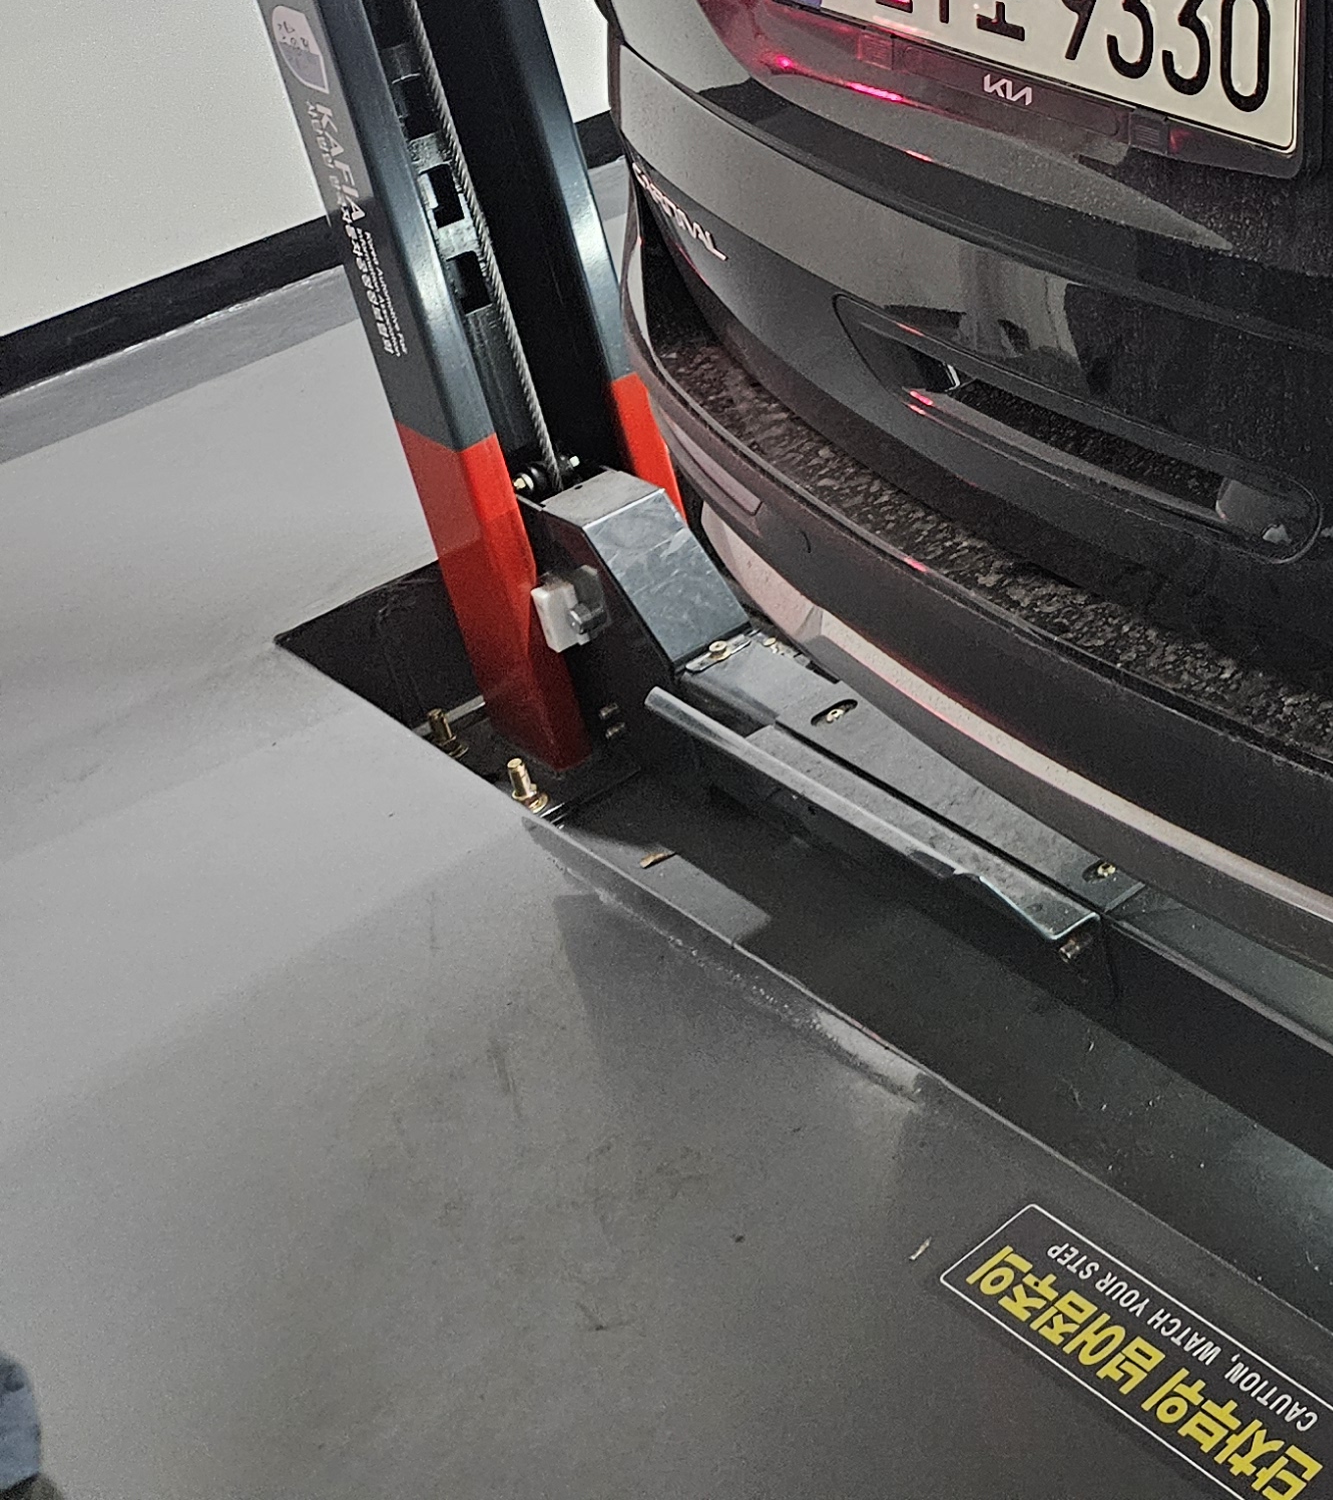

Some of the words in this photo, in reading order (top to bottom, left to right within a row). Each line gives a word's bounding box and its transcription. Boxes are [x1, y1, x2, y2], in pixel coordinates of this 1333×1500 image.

[983, 72, 1032, 106] KIA
[316, 103, 366, 221] KAFIA
[1046, 1242, 1101, 1281] STEP
[1095, 1267, 1151, 1318] YOUR
[965, 1244, 1166, 1396] 넘어짐주의
[1151, 1308, 1222, 1366] WATCH
[1224, 1352, 1318, 1432] CAUTION,
[1141, 1366, 1323, 1500] 단차부위
